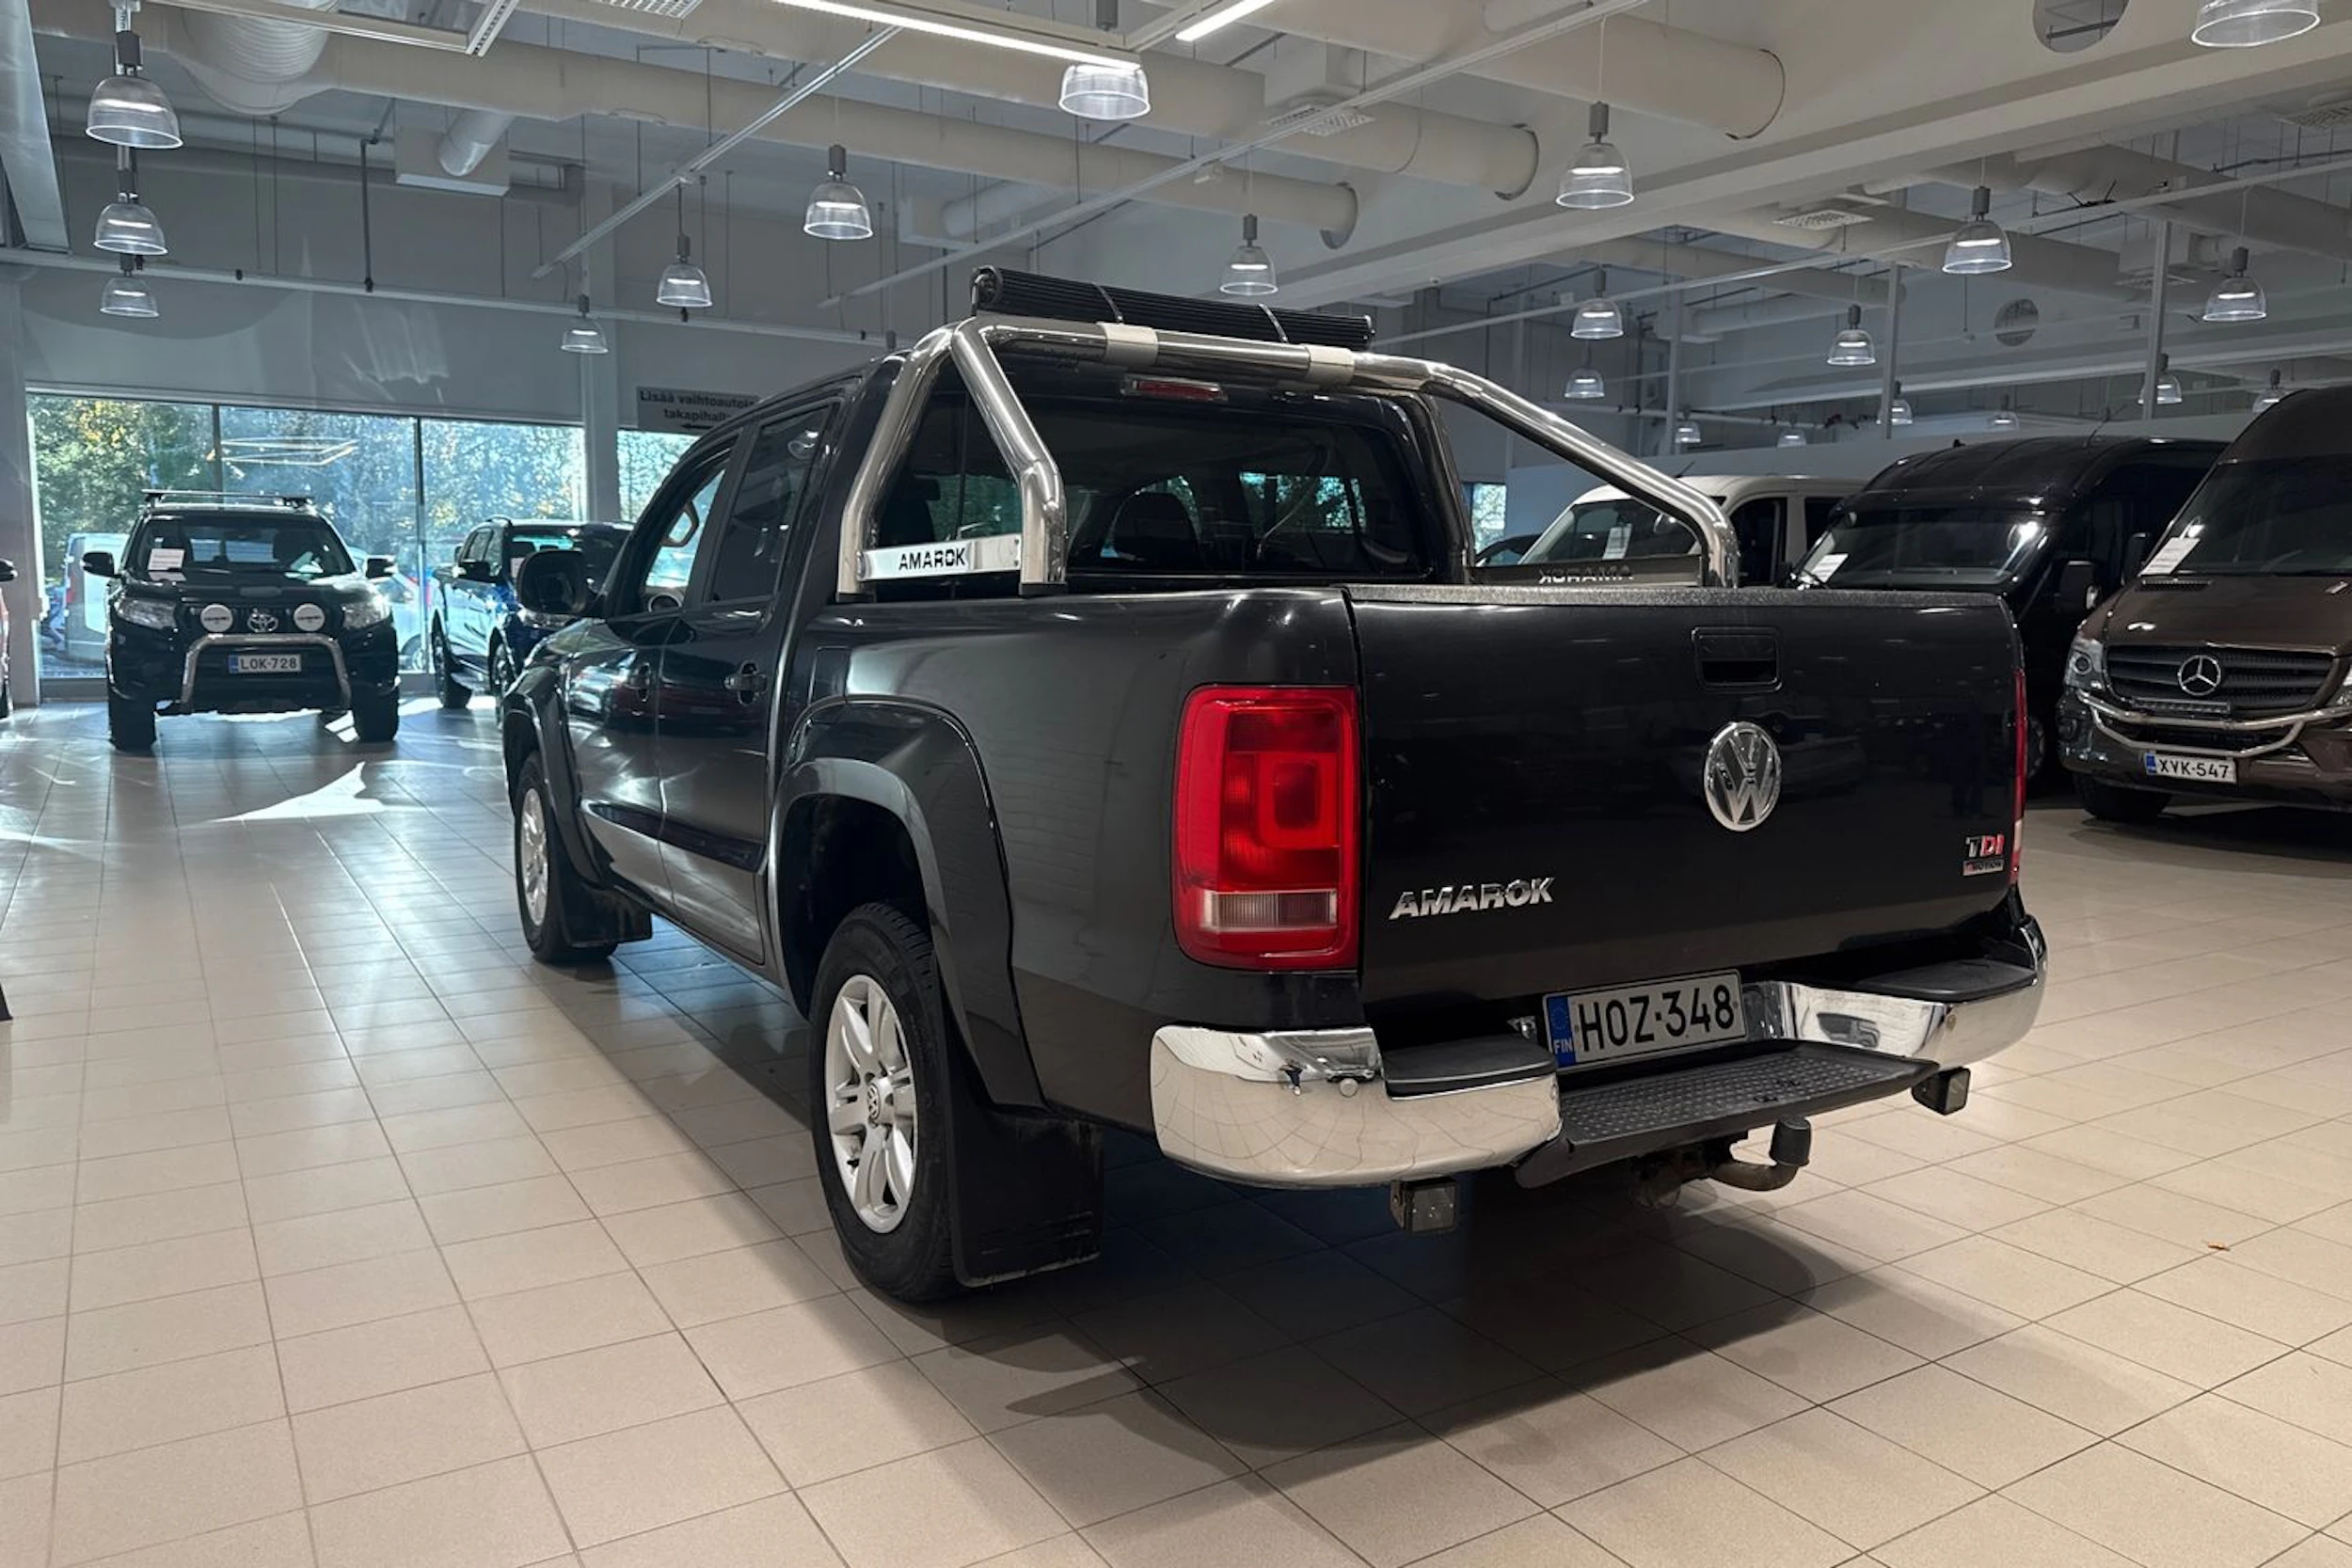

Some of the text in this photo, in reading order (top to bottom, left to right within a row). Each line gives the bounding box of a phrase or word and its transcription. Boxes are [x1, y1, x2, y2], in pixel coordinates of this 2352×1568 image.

[664, 409, 733, 422] takapihall
[898, 547, 965, 570] AMAROK
[241, 658, 297, 671] LOK-728
[2159, 758, 2229, 779] XVK-547
[1965, 833, 2005, 857] TDI
[1389, 878, 1554, 920] AMAROK
[1553, 984, 1735, 1055] FIN HOZ-348
